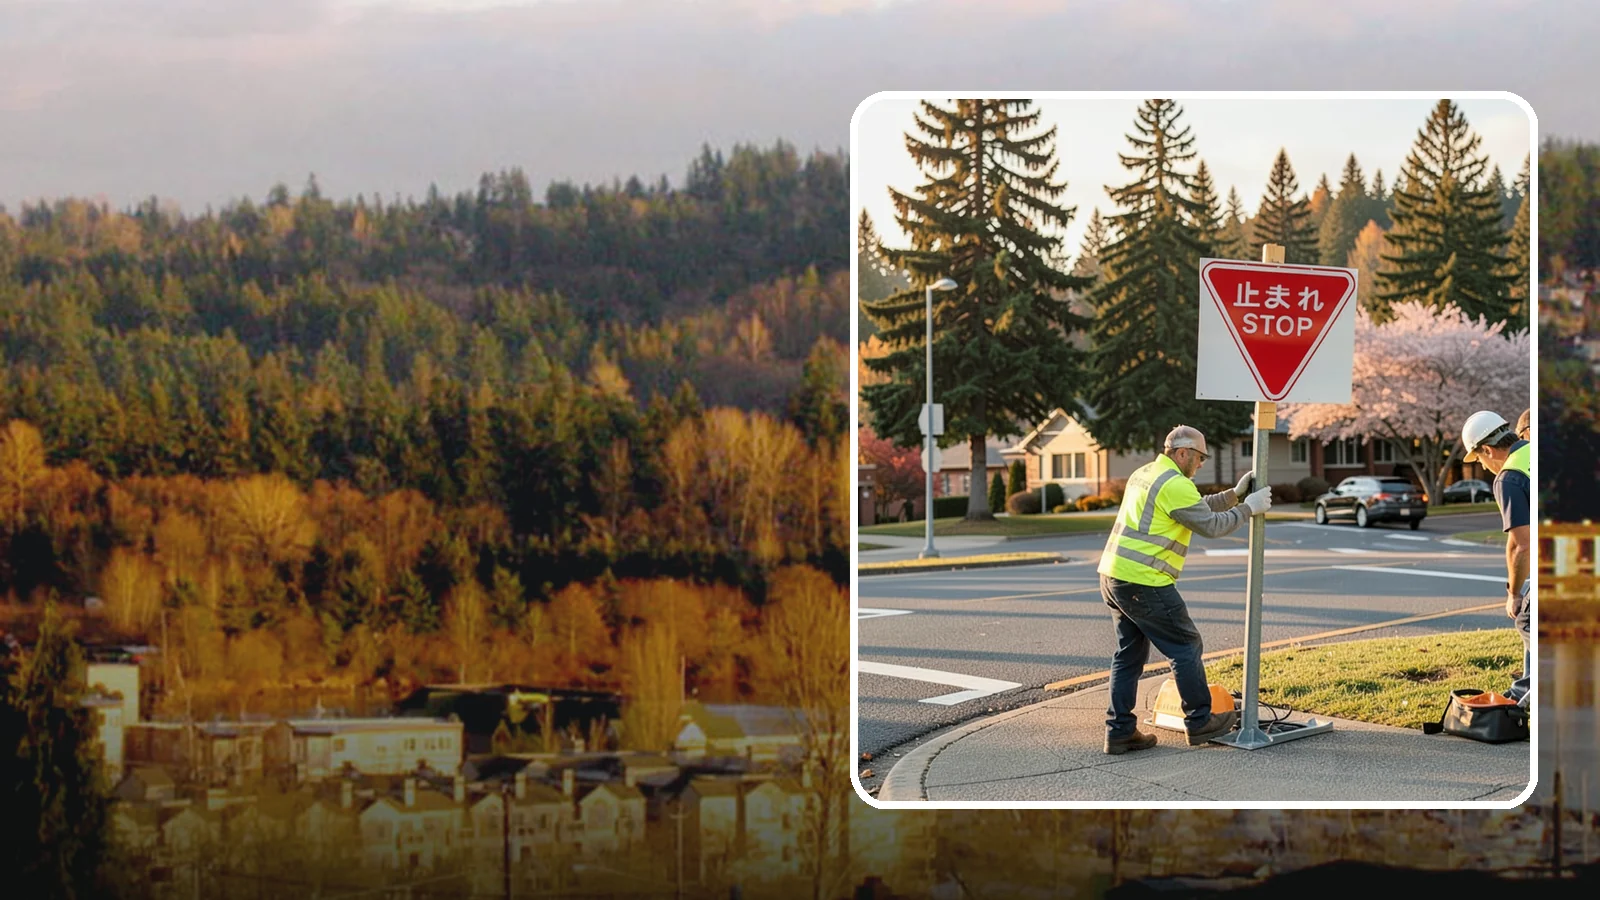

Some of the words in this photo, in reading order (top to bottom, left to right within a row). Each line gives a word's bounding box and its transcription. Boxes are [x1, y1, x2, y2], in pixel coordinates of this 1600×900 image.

[1233, 281, 1324, 312] 止まれ
[1242, 313, 1313, 336] STOP
